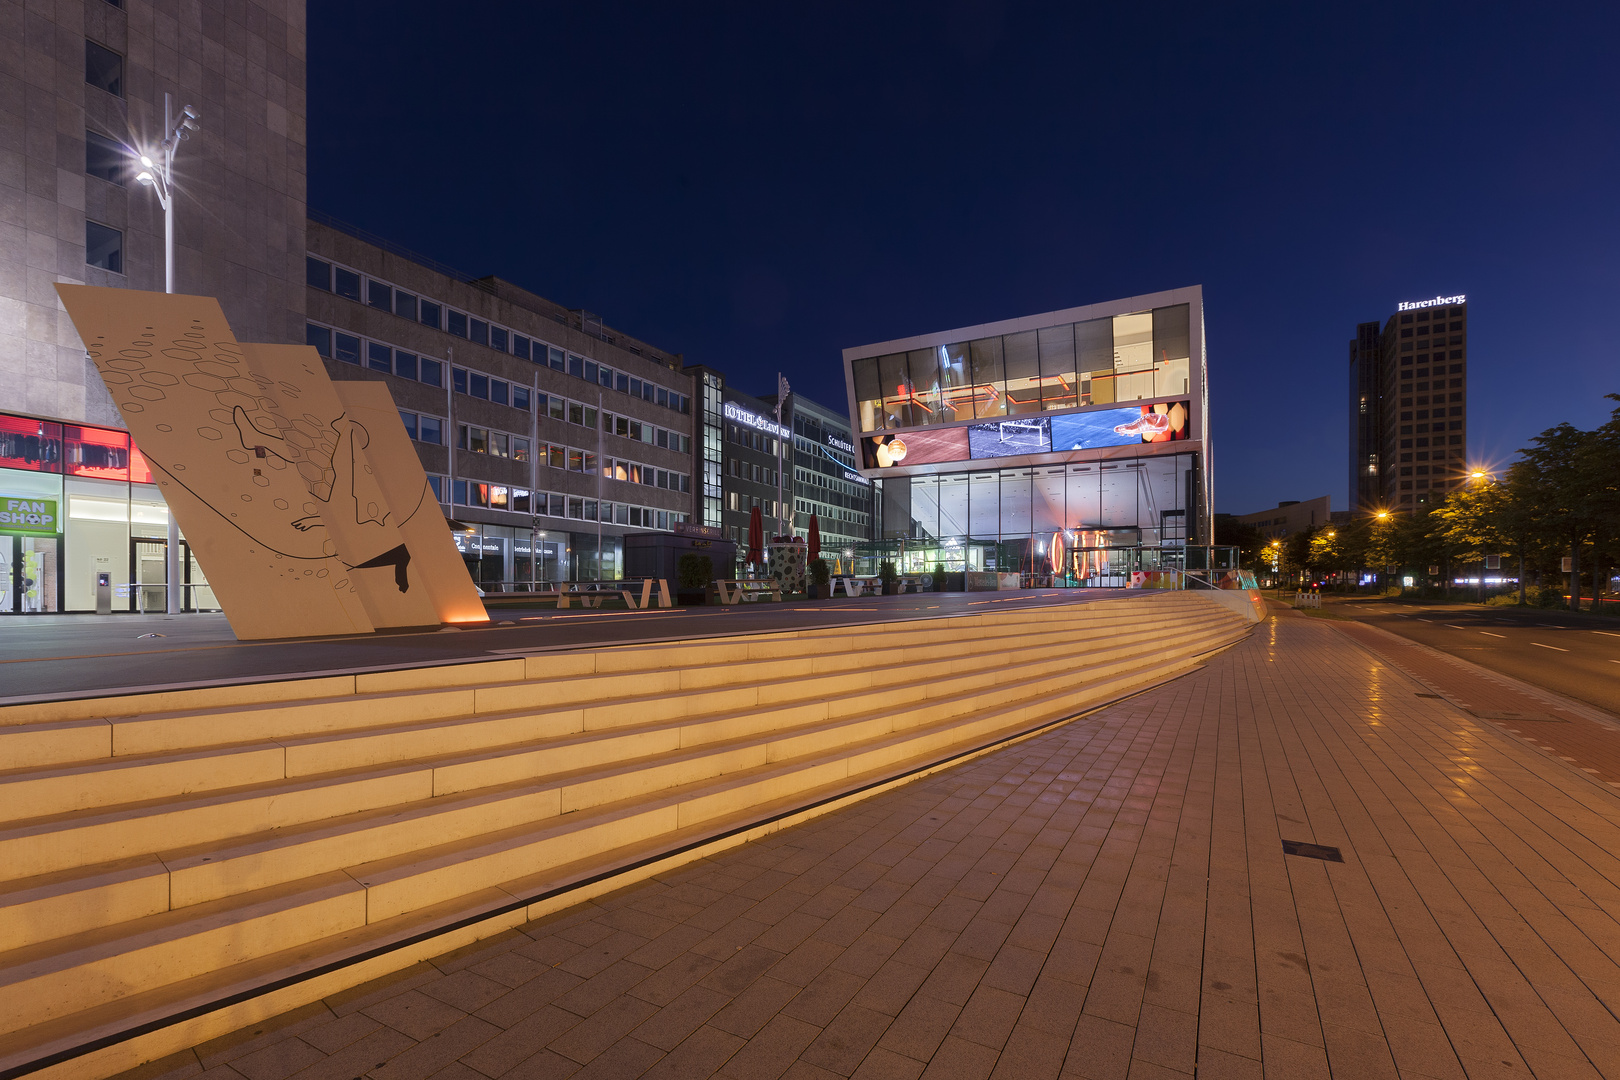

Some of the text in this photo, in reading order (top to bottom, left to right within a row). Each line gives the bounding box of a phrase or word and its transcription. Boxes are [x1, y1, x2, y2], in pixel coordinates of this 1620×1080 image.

[1398, 294, 1466, 311] Harenberg
[7, 499, 46, 513] FAN
[0, 511, 54, 526] SHOP
